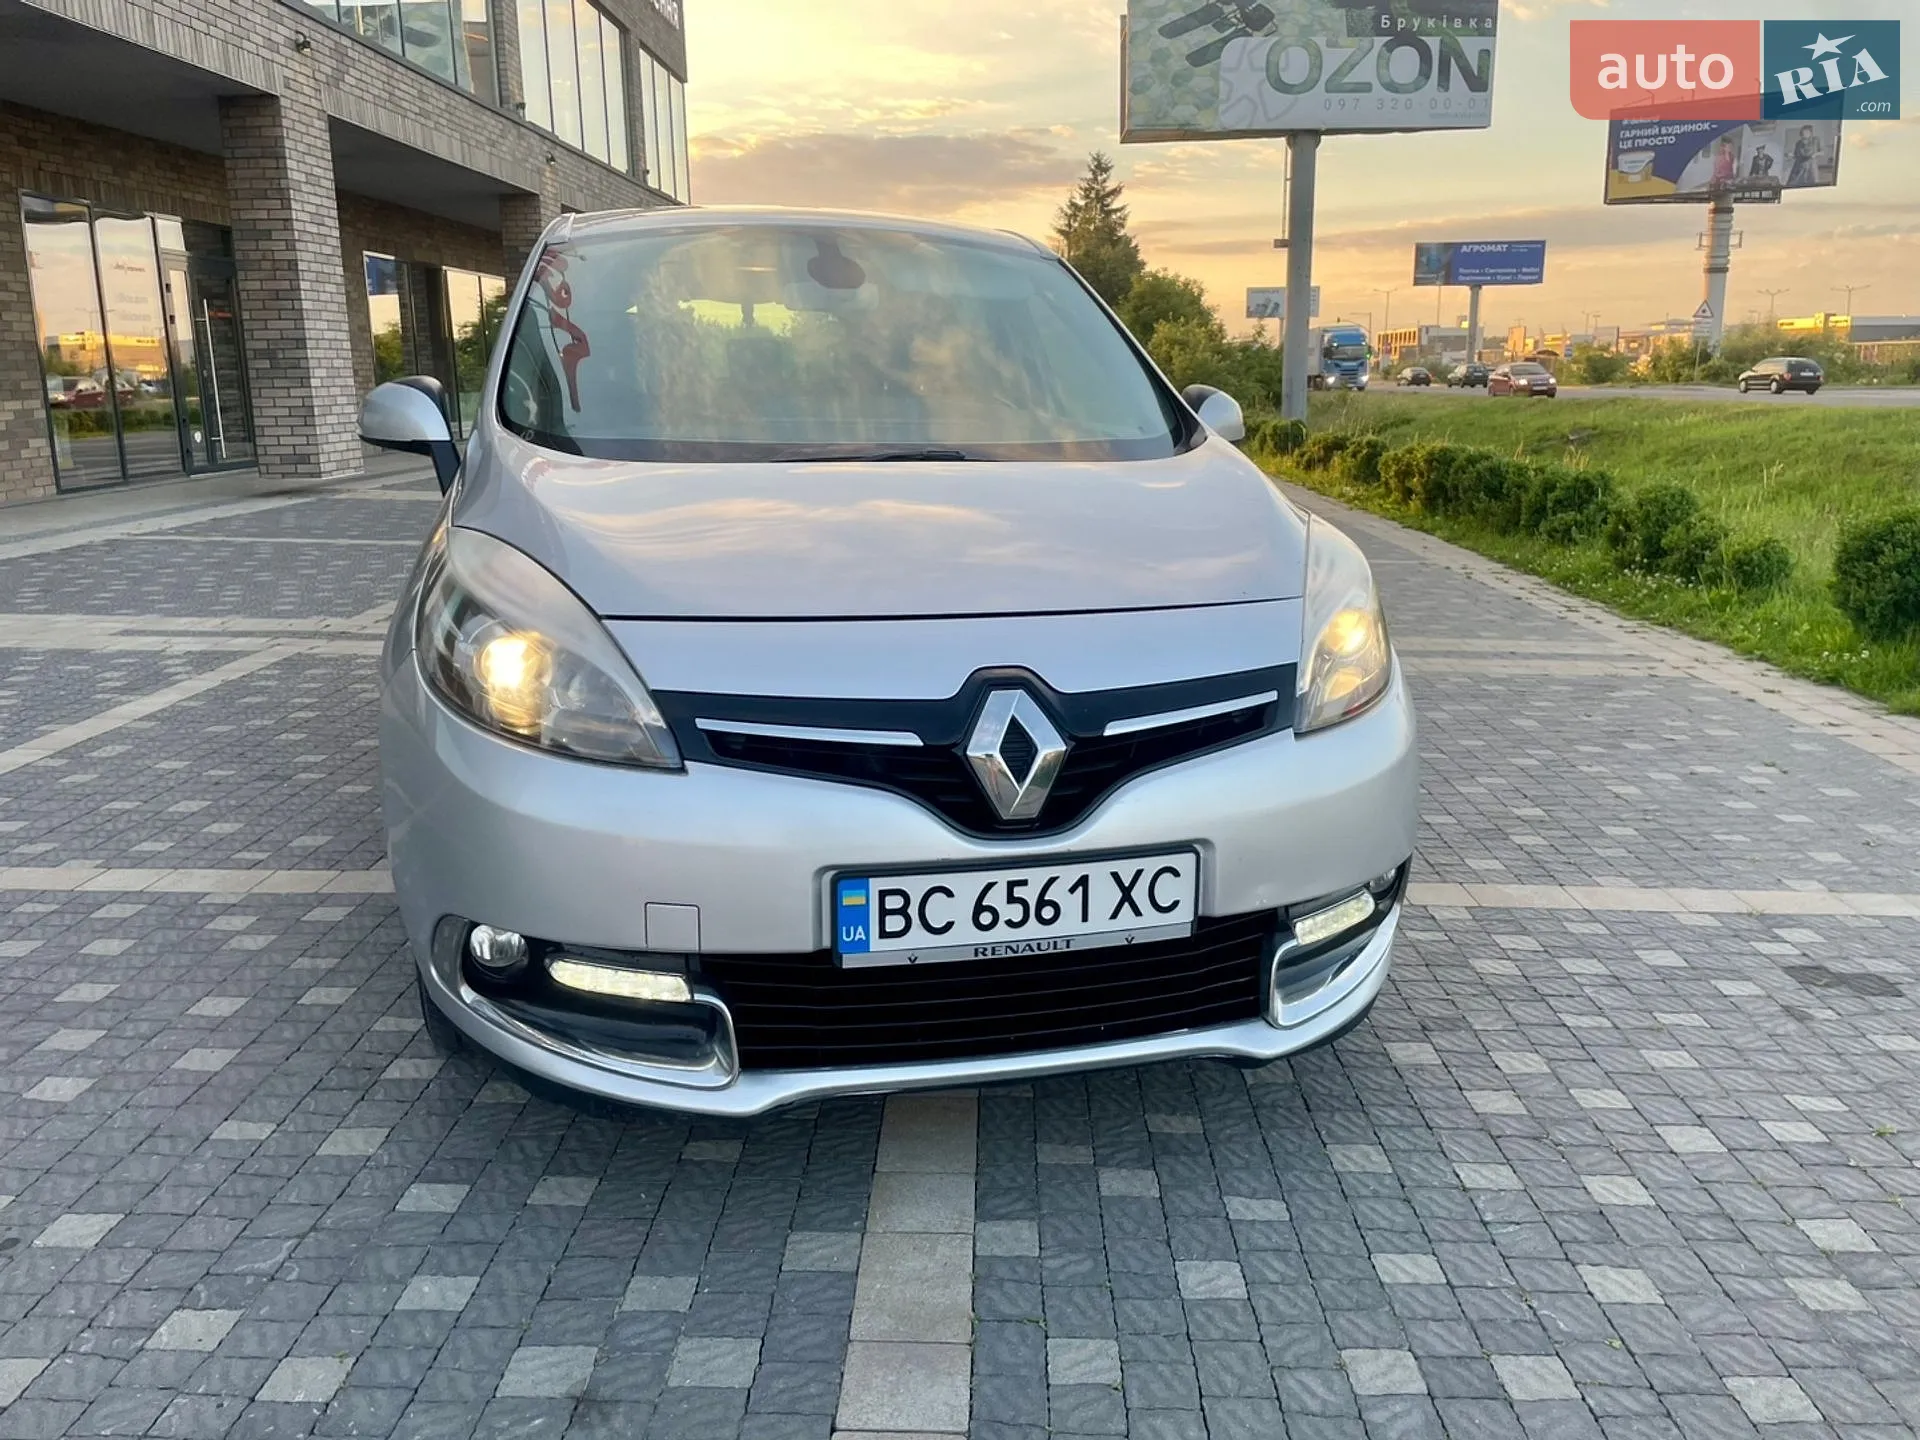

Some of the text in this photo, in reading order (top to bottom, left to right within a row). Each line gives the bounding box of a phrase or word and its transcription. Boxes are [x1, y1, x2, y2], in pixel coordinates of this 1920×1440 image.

[1381, 15, 1493, 32] Бруківка
[1265, 34, 1491, 95] OZON
[1324, 98, 1361, 111] 097
[1620, 125, 1660, 138] ГАРНИЙ
[1619, 136, 1676, 149] ЦЕ ПРОСТО
[1460, 244, 1508, 253] АГРОМАТ
[878, 866, 1182, 939] BC 6561 XC
[842, 925, 866, 942] UA
[973, 938, 1076, 958] RENAULT
